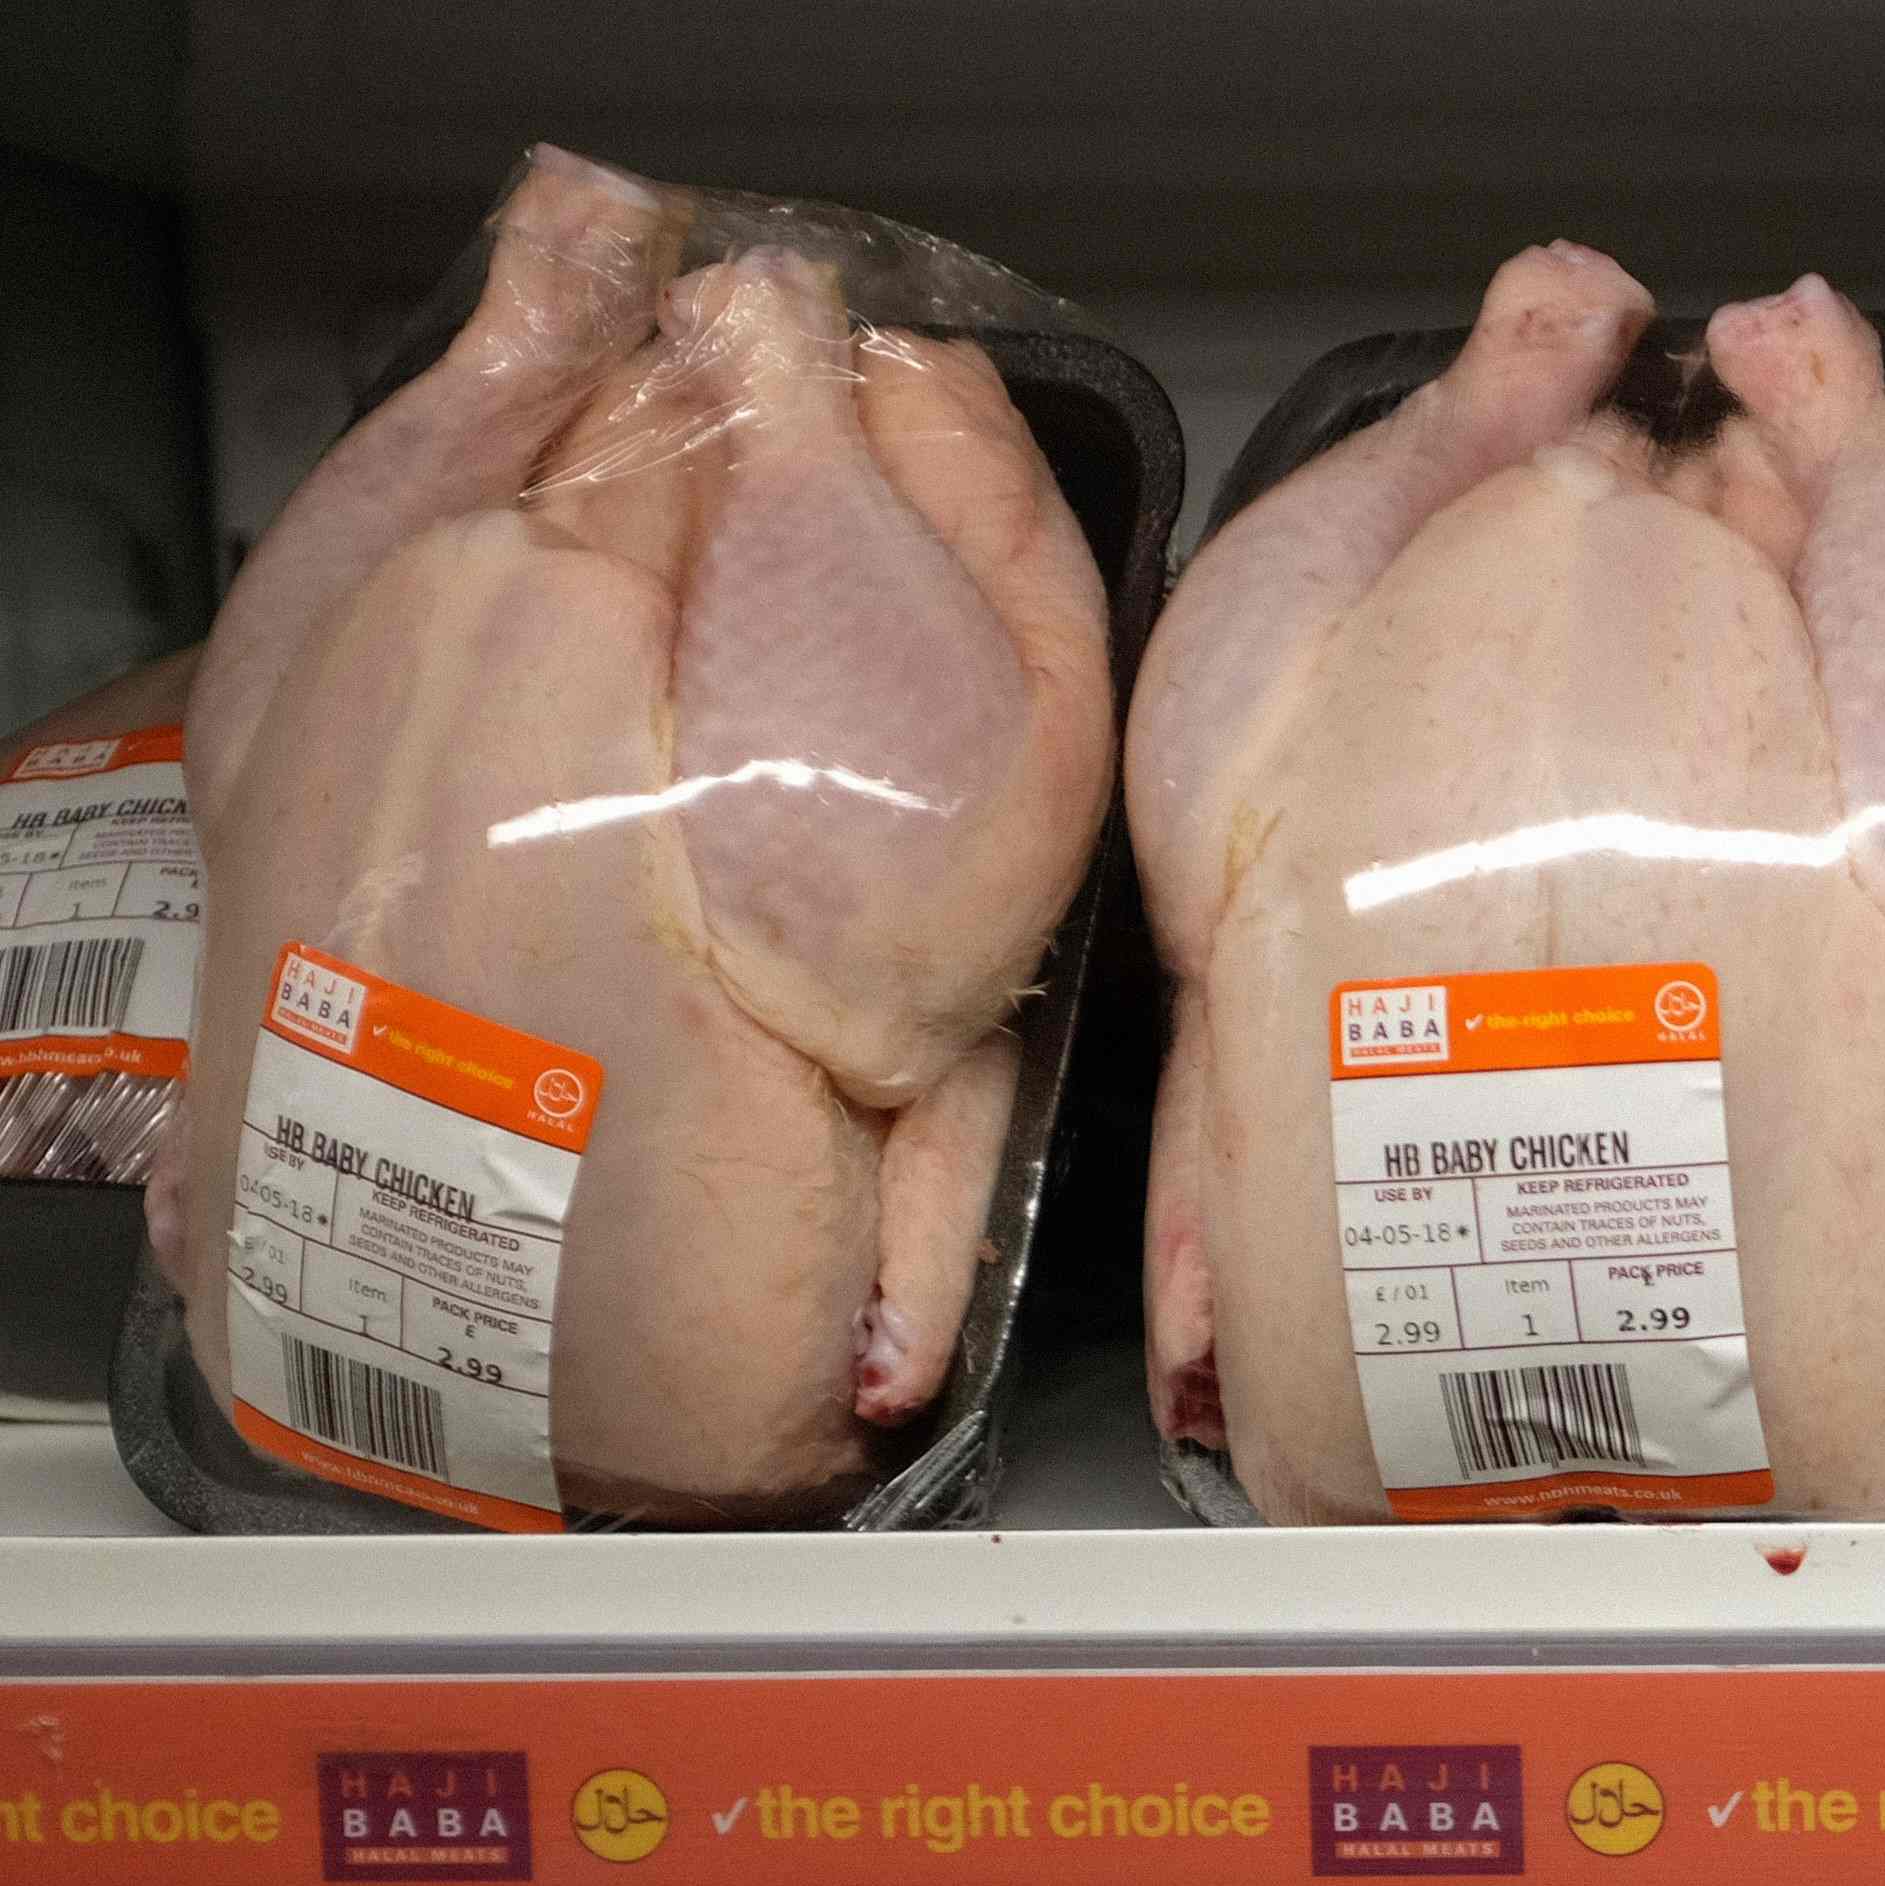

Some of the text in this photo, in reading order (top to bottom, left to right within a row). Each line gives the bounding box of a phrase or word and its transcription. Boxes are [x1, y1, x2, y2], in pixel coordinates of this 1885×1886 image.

[53, 805, 111, 827] BABY
[287, 960, 357, 1003] HAJI
[281, 983, 350, 1028] BABA
[1348, 992, 1435, 1018] HAJI
[1349, 1018, 1440, 1042] BABA
[276, 1115, 476, 1221] HB BABY CHICKEN
[1384, 1130, 1631, 1177] HB BABY CHICKEN
[1374, 1186, 1434, 1202] USE BY
[1517, 1173, 1690, 1196] KEEP REFRIGERATED
[372, 1190, 520, 1252] KEEP REFRIGERATED
[1608, 1262, 1704, 1280] PACK PRICE
[1504, 1278, 1550, 1295] Item
[432, 1298, 518, 1335] PACK PRICE
[1522, 1313, 1538, 1336] 1
[1616, 1307, 1690, 1332] 2.99
[1376, 1322, 1440, 1346] 2.99
[437, 1347, 503, 1385] 2.99
[342, 1769, 499, 1798] HAJI
[1334, 1763, 1490, 1793] HAJI
[63, 1779, 281, 1844] choice
[756, 1783, 1271, 1853] the right choice
[1334, 1803, 1500, 1832] BABA
[1752, 1779, 1857, 1834] the
[343, 1809, 508, 1838] BABA
[1342, 1843, 1496, 1858] HALAL MEATS
